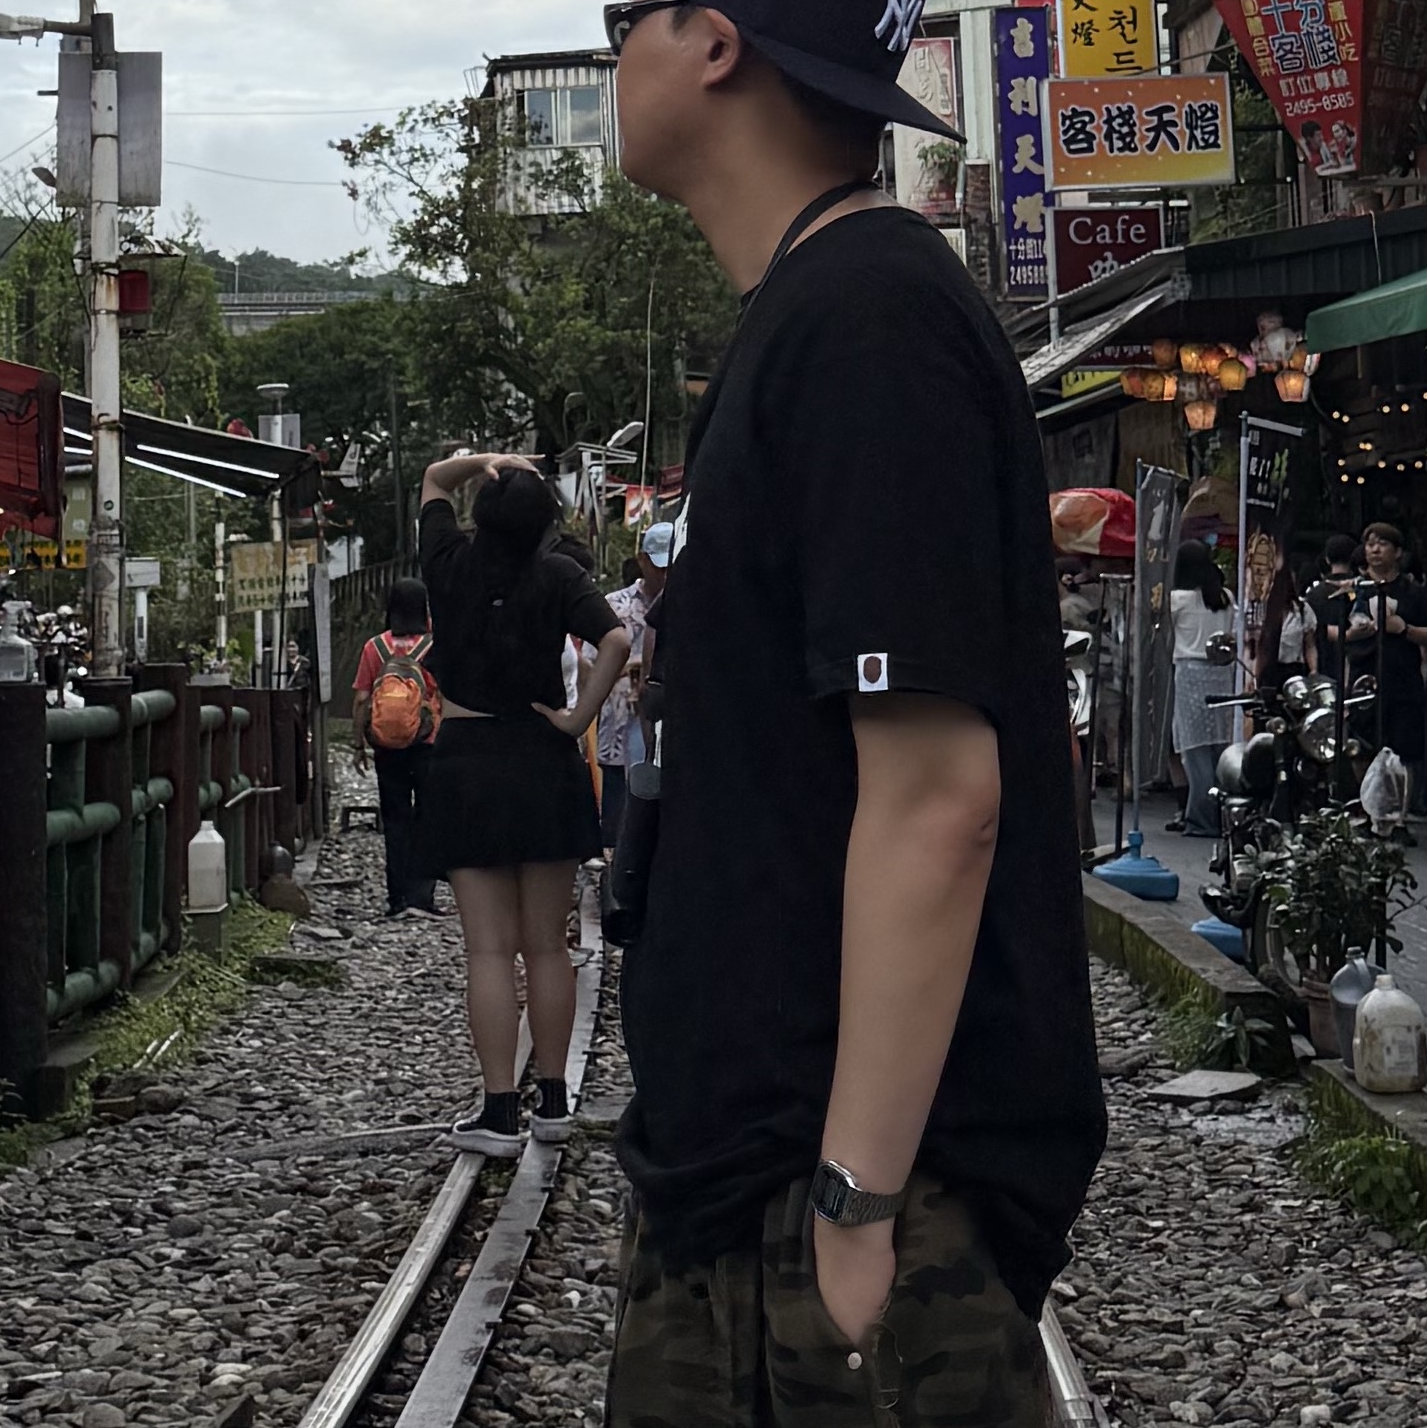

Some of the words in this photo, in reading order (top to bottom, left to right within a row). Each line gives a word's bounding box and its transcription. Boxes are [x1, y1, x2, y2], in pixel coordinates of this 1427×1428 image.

[1269, 24, 1341, 74] 客棧
[1059, 102, 1223, 156] 客棧天燈
[1008, 237, 1045, 261] 十分街11
[1068, 215, 1148, 246] Cafe
